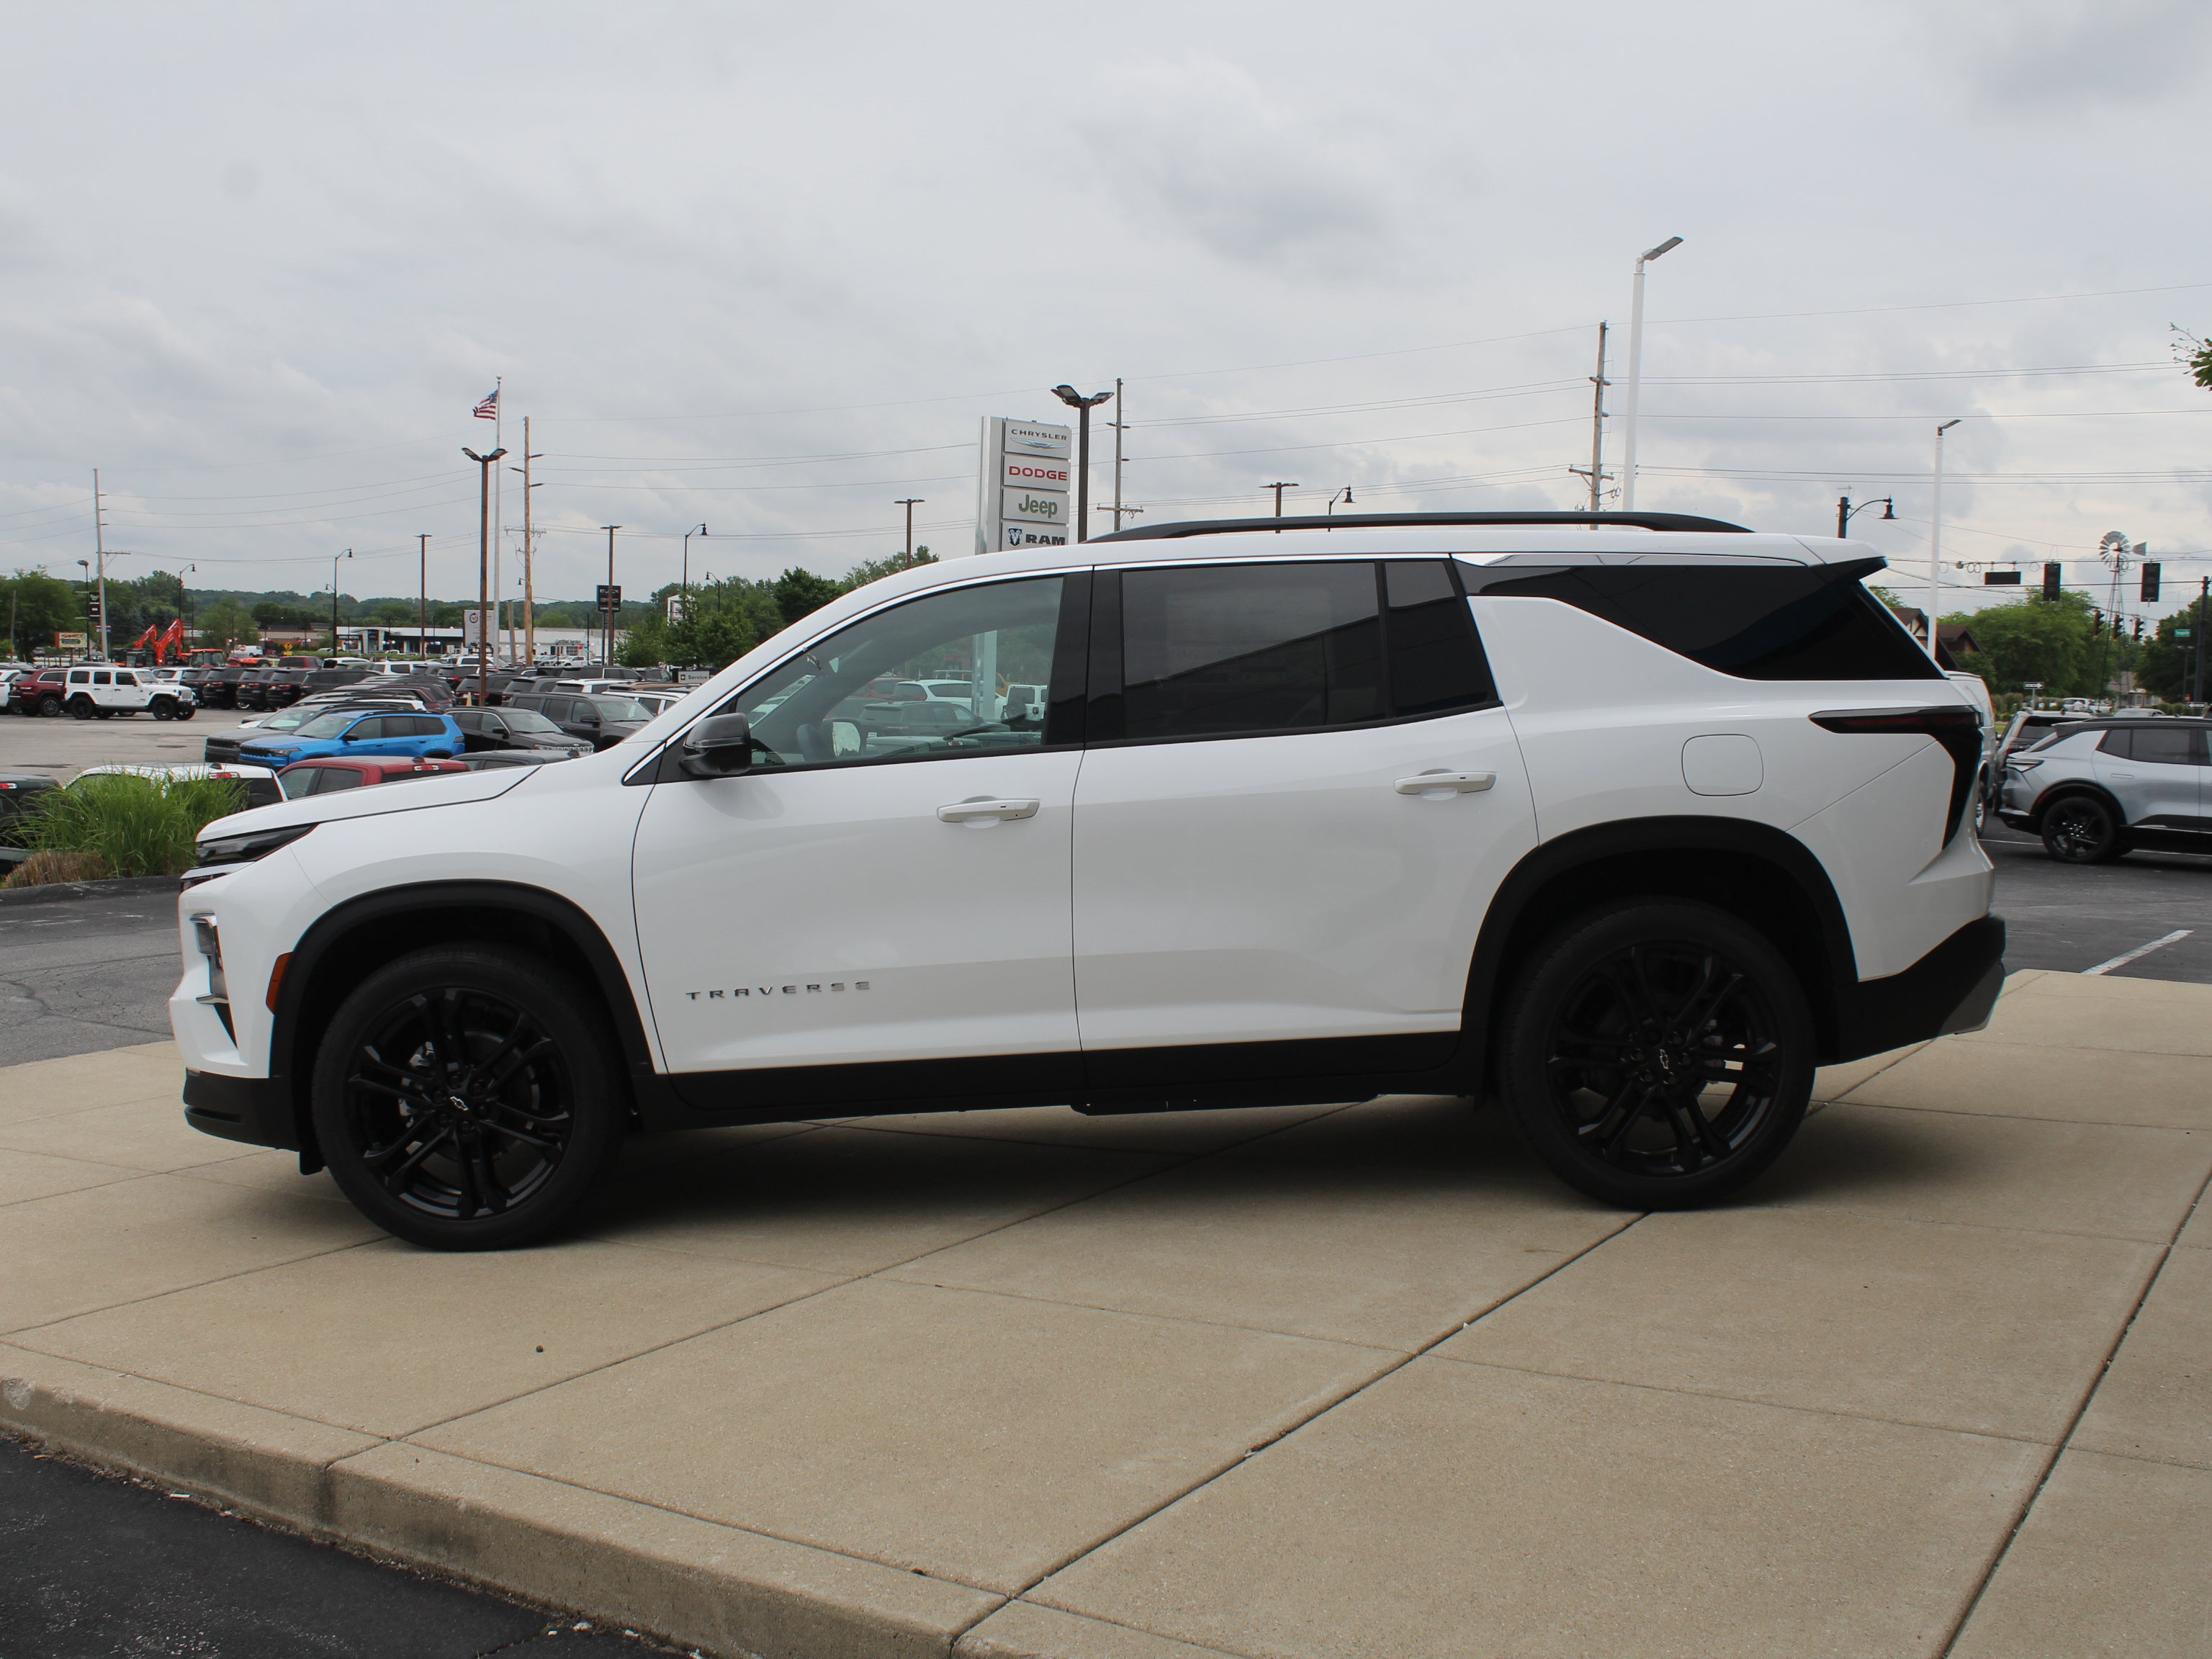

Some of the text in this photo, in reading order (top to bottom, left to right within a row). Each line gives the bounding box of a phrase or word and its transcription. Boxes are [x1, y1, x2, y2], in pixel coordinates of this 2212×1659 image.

[1011, 428, 1067, 441] CHRYSLER
[1009, 466, 1067, 481] DODGE
[1018, 494, 1058, 518] Jeep
[1025, 534, 1066, 545] RAM
[685, 981, 870, 1000] TRAVERSE
